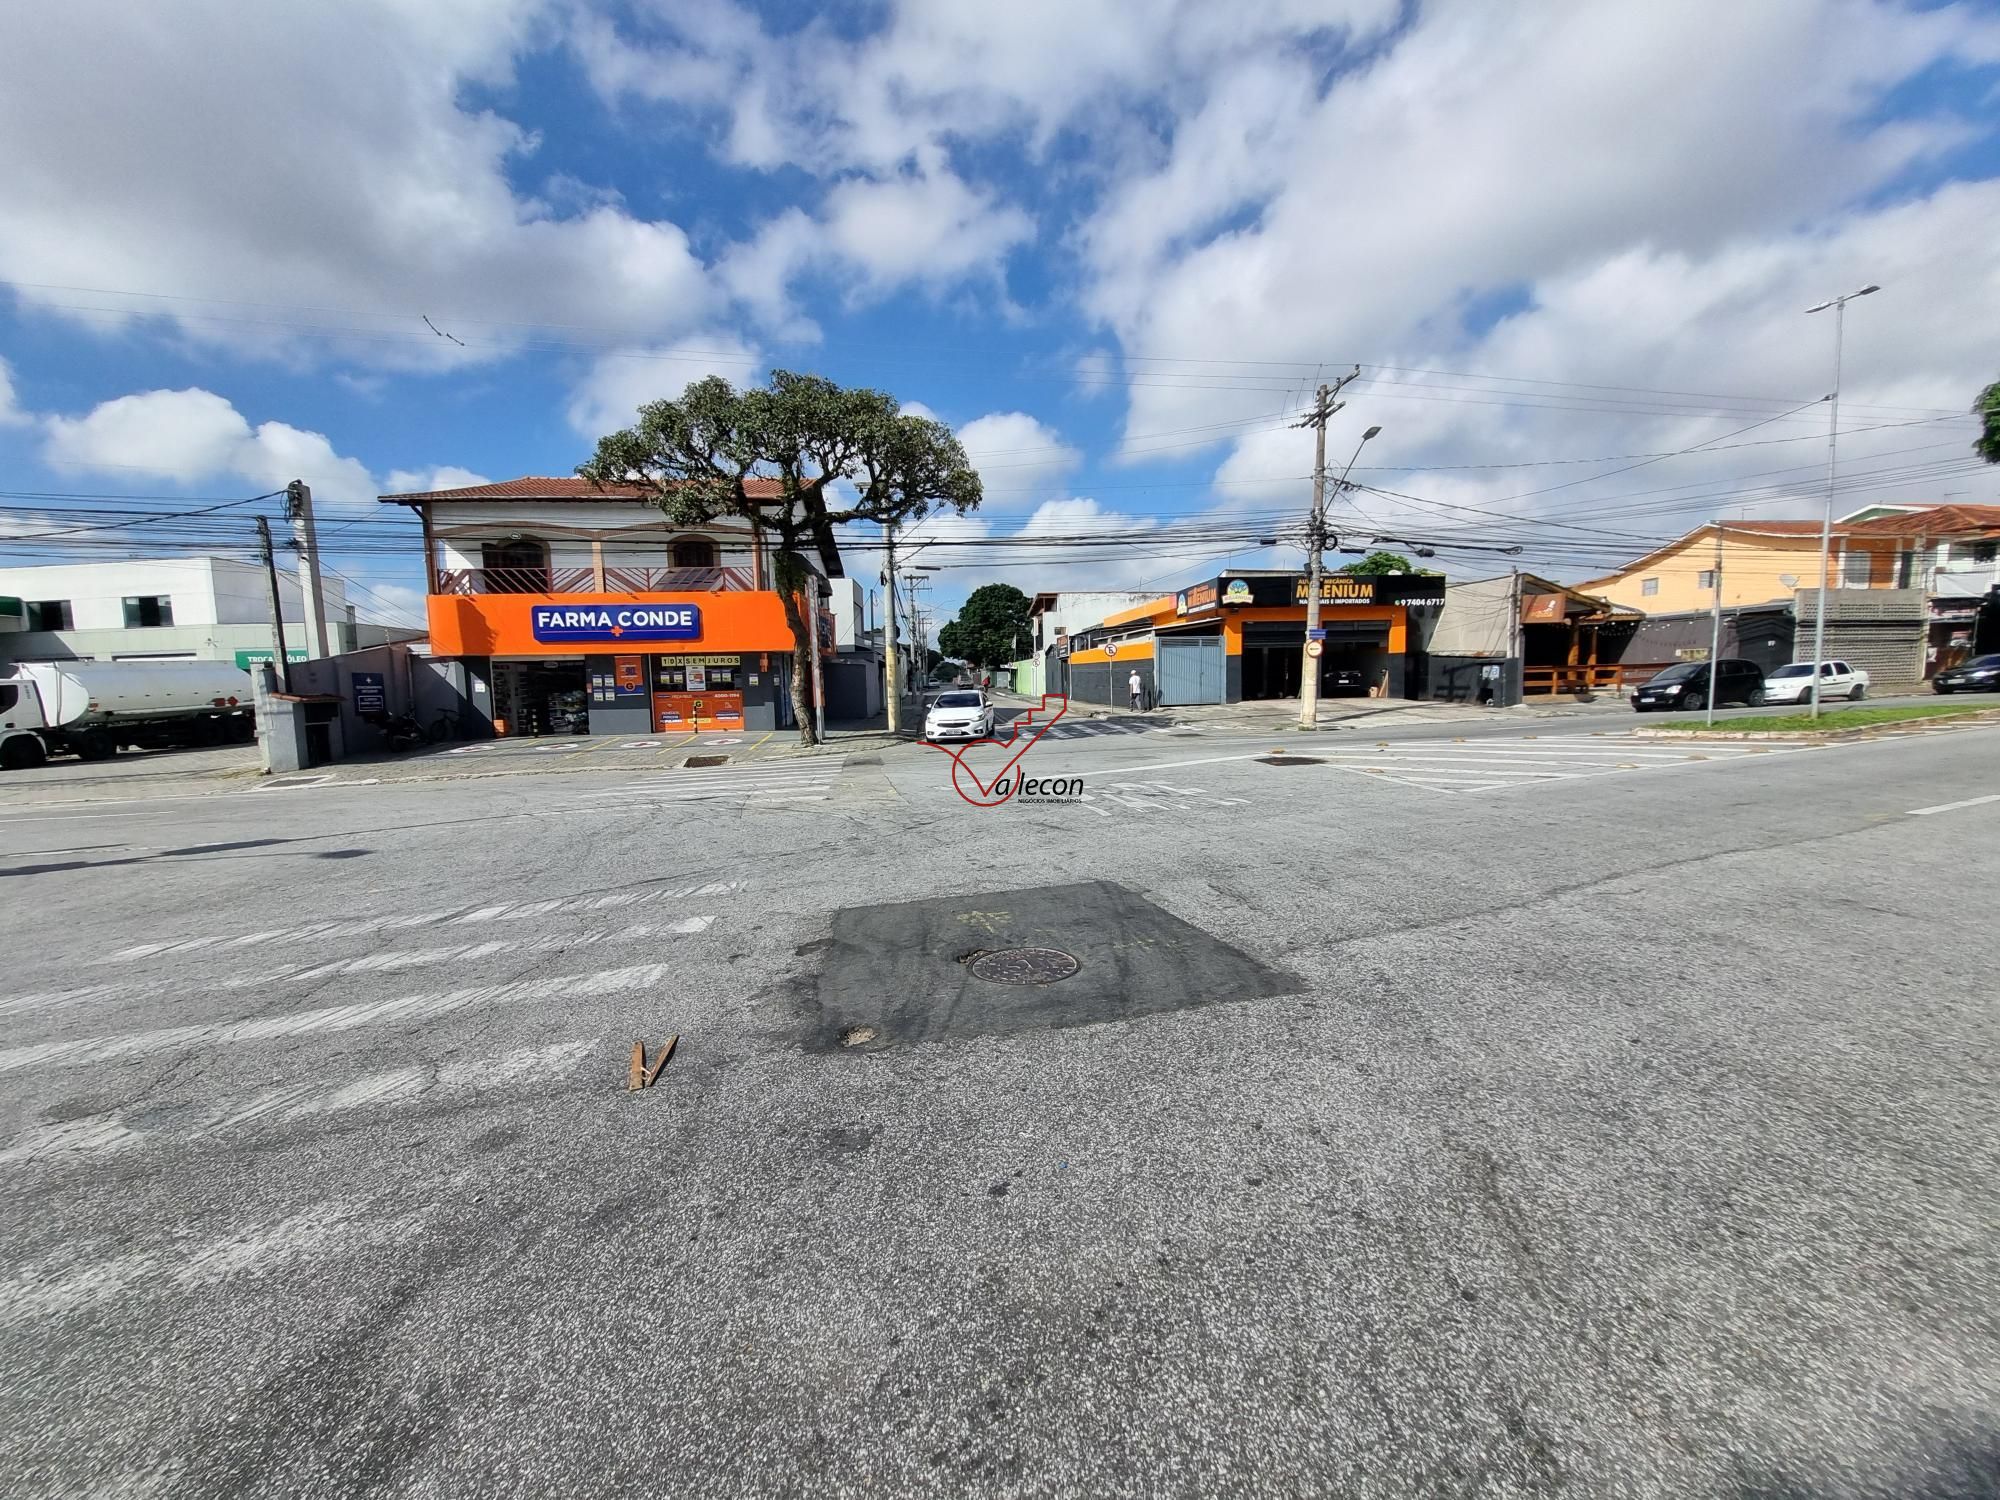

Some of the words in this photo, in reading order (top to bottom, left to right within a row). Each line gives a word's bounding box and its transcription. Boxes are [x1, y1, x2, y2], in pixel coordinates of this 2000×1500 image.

[1426, 598, 1446, 606] 6717
[538, 612, 612, 628] FARMA
[617, 611, 692, 627] CONDE
[287, 654, 307, 663] ÓLEO
[685, 657, 705, 665] SEM
